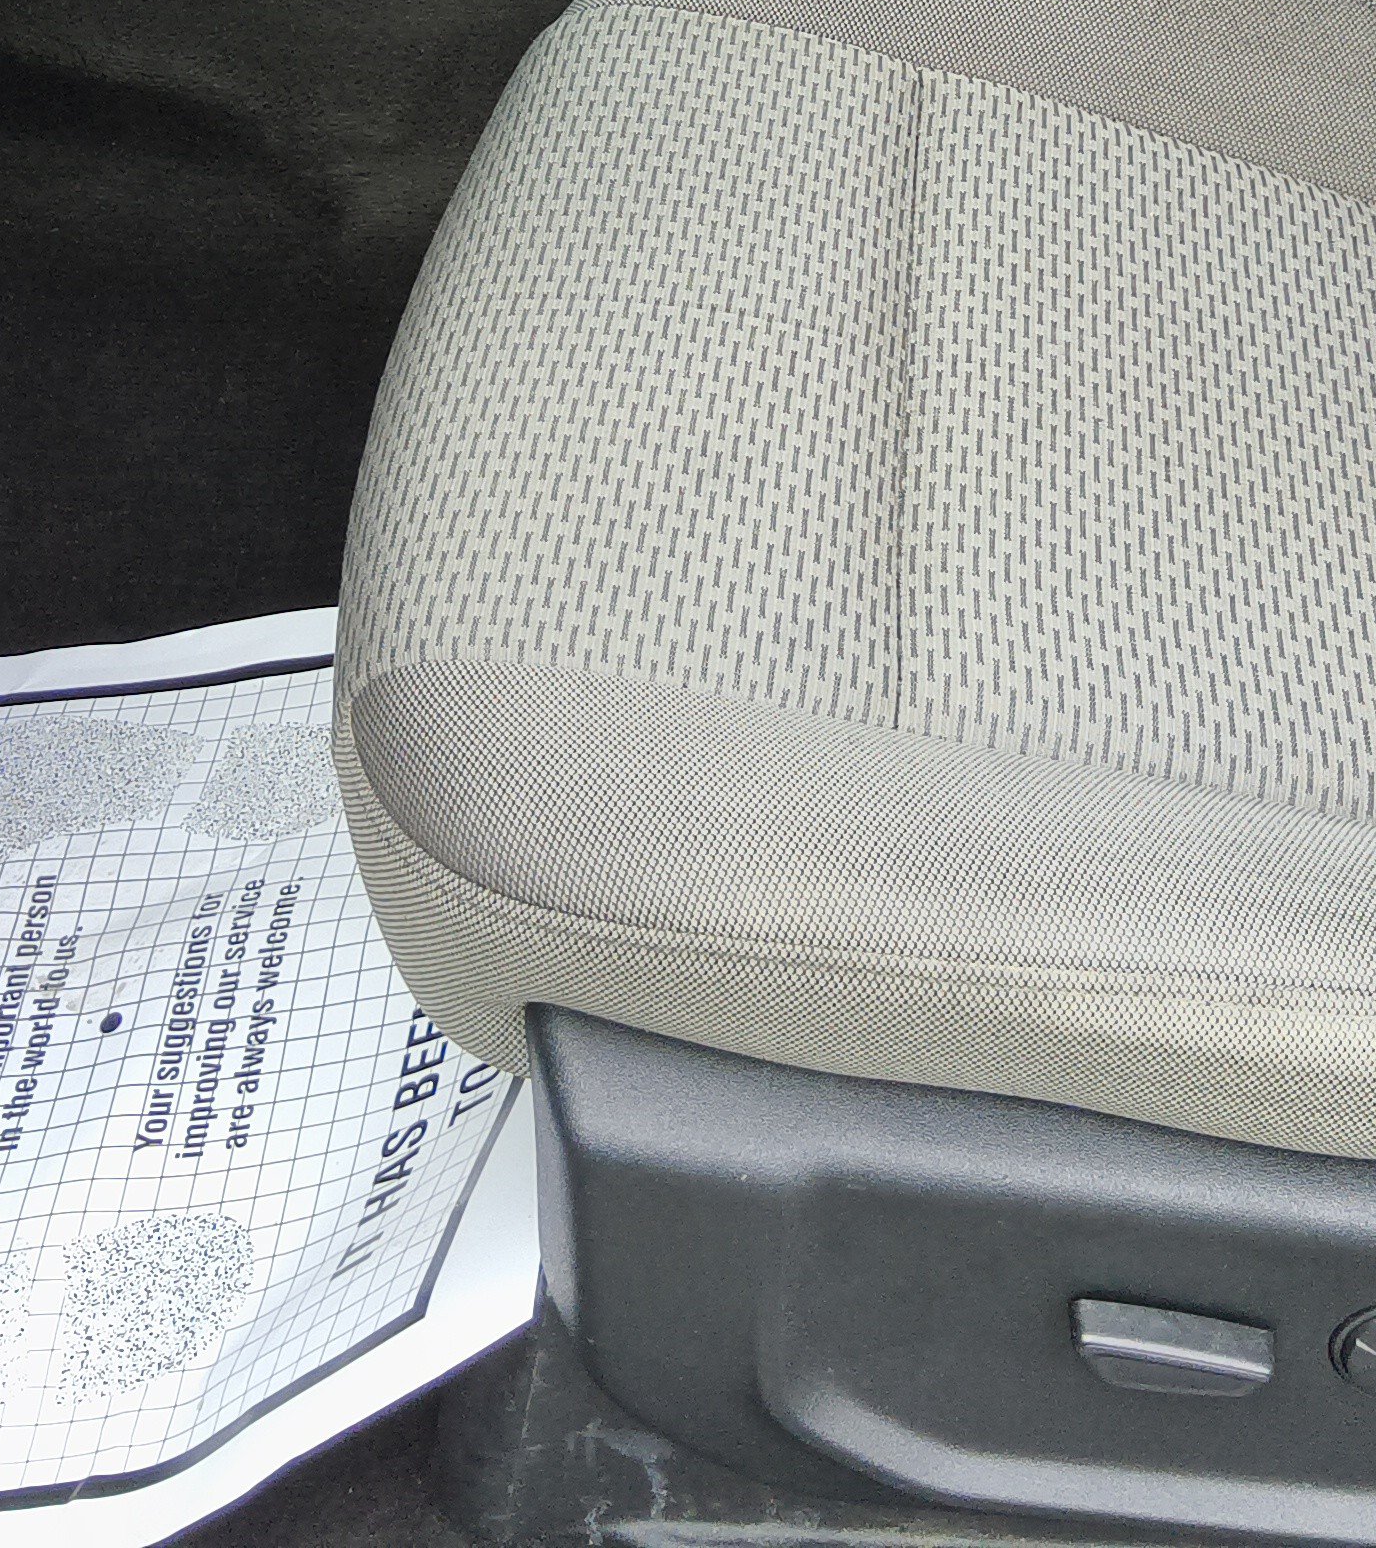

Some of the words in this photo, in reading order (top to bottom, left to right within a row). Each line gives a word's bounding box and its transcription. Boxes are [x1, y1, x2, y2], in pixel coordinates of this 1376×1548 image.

[15, 874, 58, 958] person
[224, 878, 265, 961] service
[39, 968, 70, 991] to
[213, 969, 241, 1011] our
[20, 997, 61, 1071] world
[132, 1088, 174, 1152] Your
[157, 924, 212, 1082] suggestions
[191, 892, 224, 920] for
[234, 999, 277, 1095] always
[392, 1008, 448, 1111] BEE
[1, 1077, 38, 1121] the
[175, 1018, 236, 1159] improving
[225, 1104, 254, 1150] are
[357, 1118, 428, 1228] HAS
[329, 1230, 384, 1282] IT
